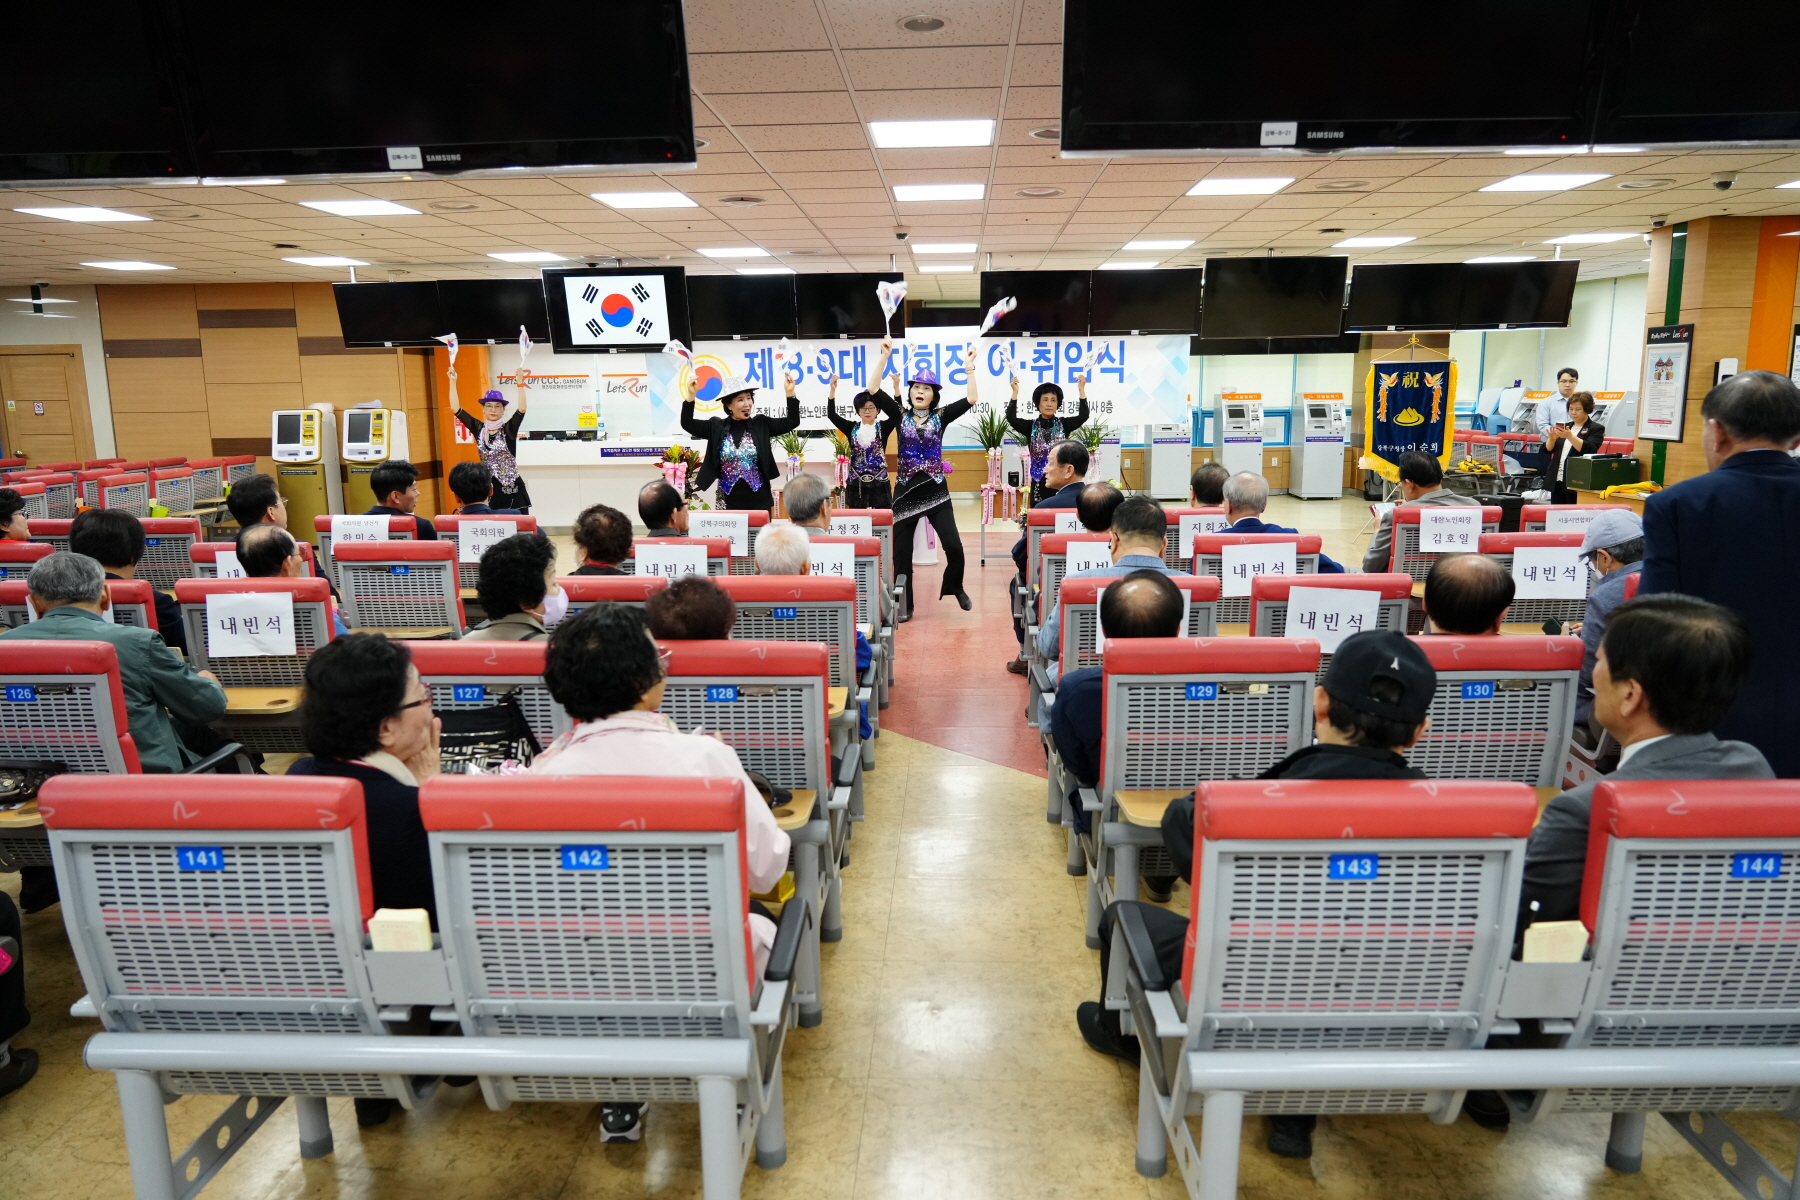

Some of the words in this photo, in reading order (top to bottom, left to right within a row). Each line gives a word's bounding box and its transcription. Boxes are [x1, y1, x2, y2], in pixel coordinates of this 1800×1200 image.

[1306, 131, 1344, 139] SAMSUNG
[425, 153, 462, 162] SAMSUNG
[1402, 371, 1419, 388] 祝
[1430, 516, 1472, 524] 대한노인회장
[470, 527, 505, 538] 국회의원
[776, 608, 794, 617] 114
[10, 688, 32, 700] 126
[457, 687, 479, 699] 127
[711, 687, 734, 699] 128
[1190, 685, 1213, 697] 129
[1466, 684, 1489, 696] 130
[184, 851, 218, 866] 141
[567, 850, 603, 866] 142
[1337, 859, 1372, 875] 143
[1740, 858, 1775, 874] 144
